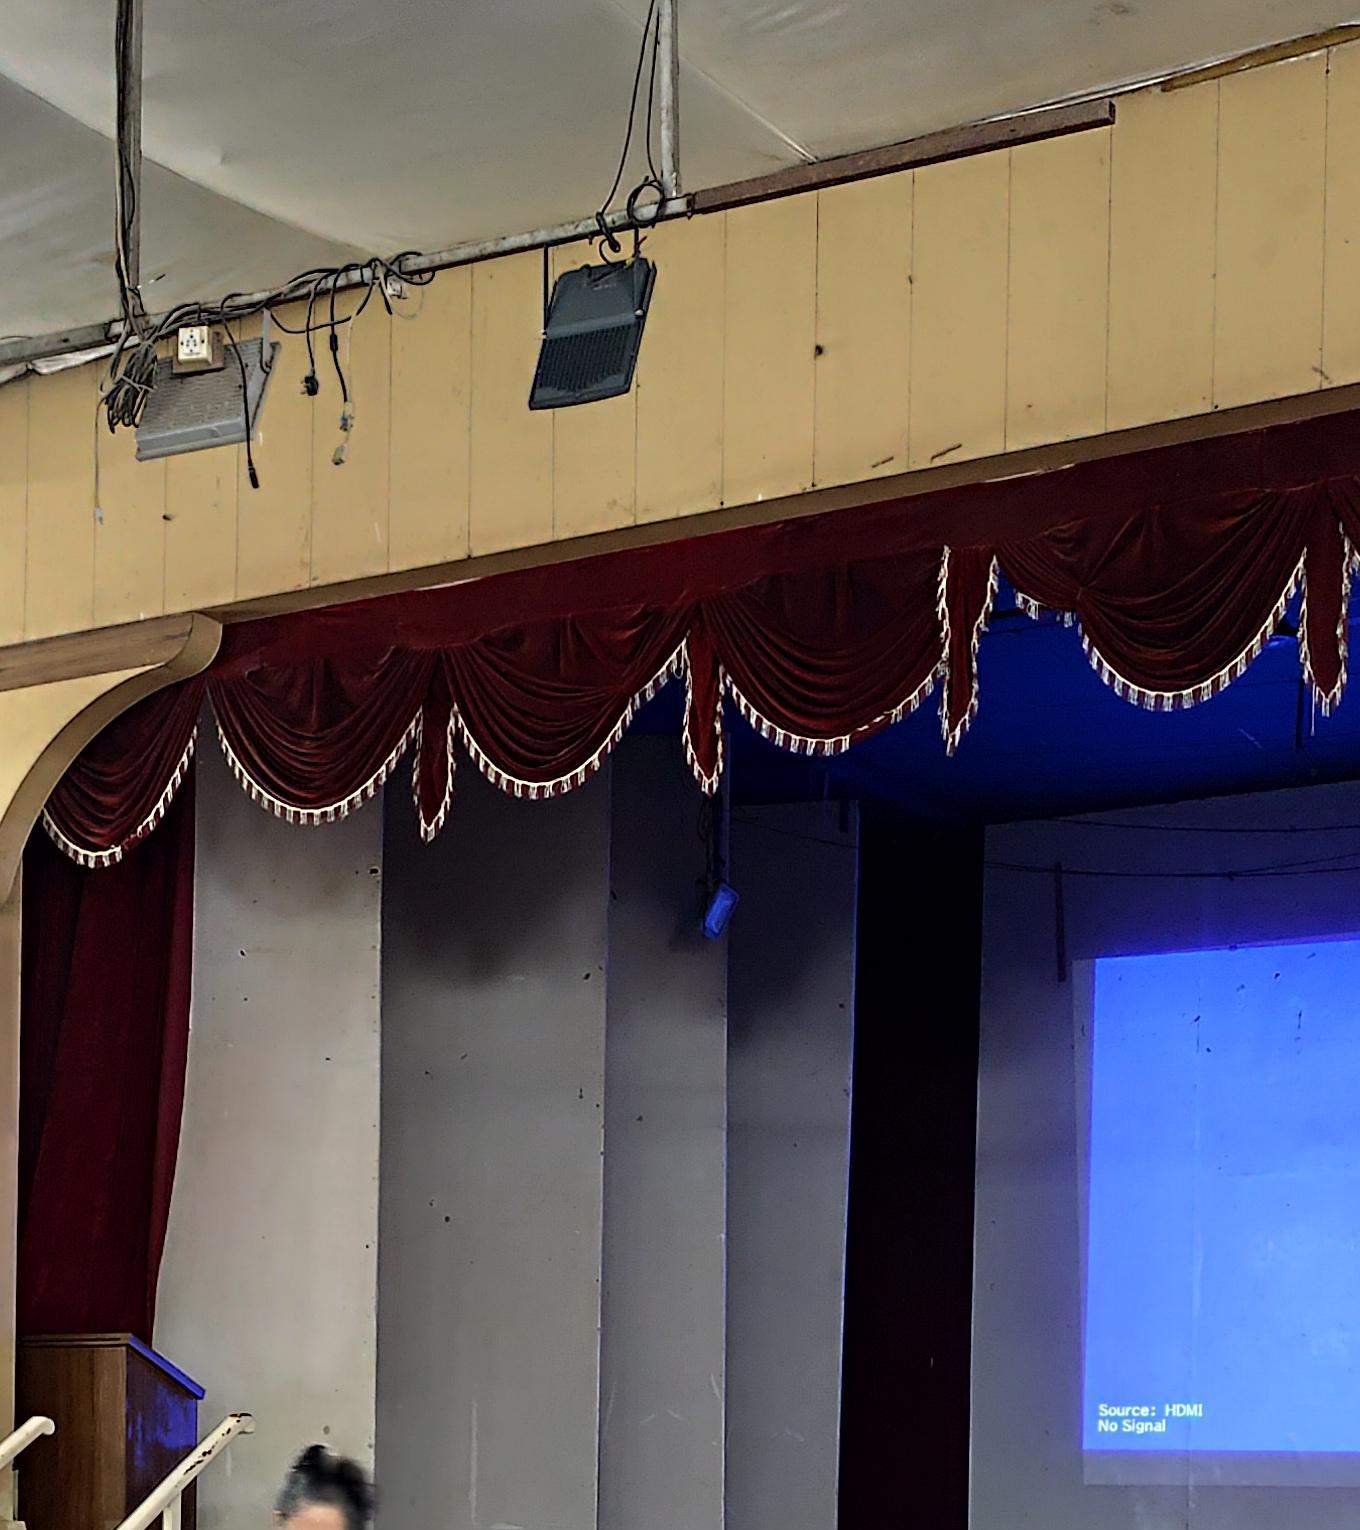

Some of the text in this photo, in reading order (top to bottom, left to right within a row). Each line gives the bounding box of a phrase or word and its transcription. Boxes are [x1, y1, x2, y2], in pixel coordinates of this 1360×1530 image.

[1098, 1403, 1203, 1417] Source: HDMI
[1097, 1418, 1166, 1434] No Signal
